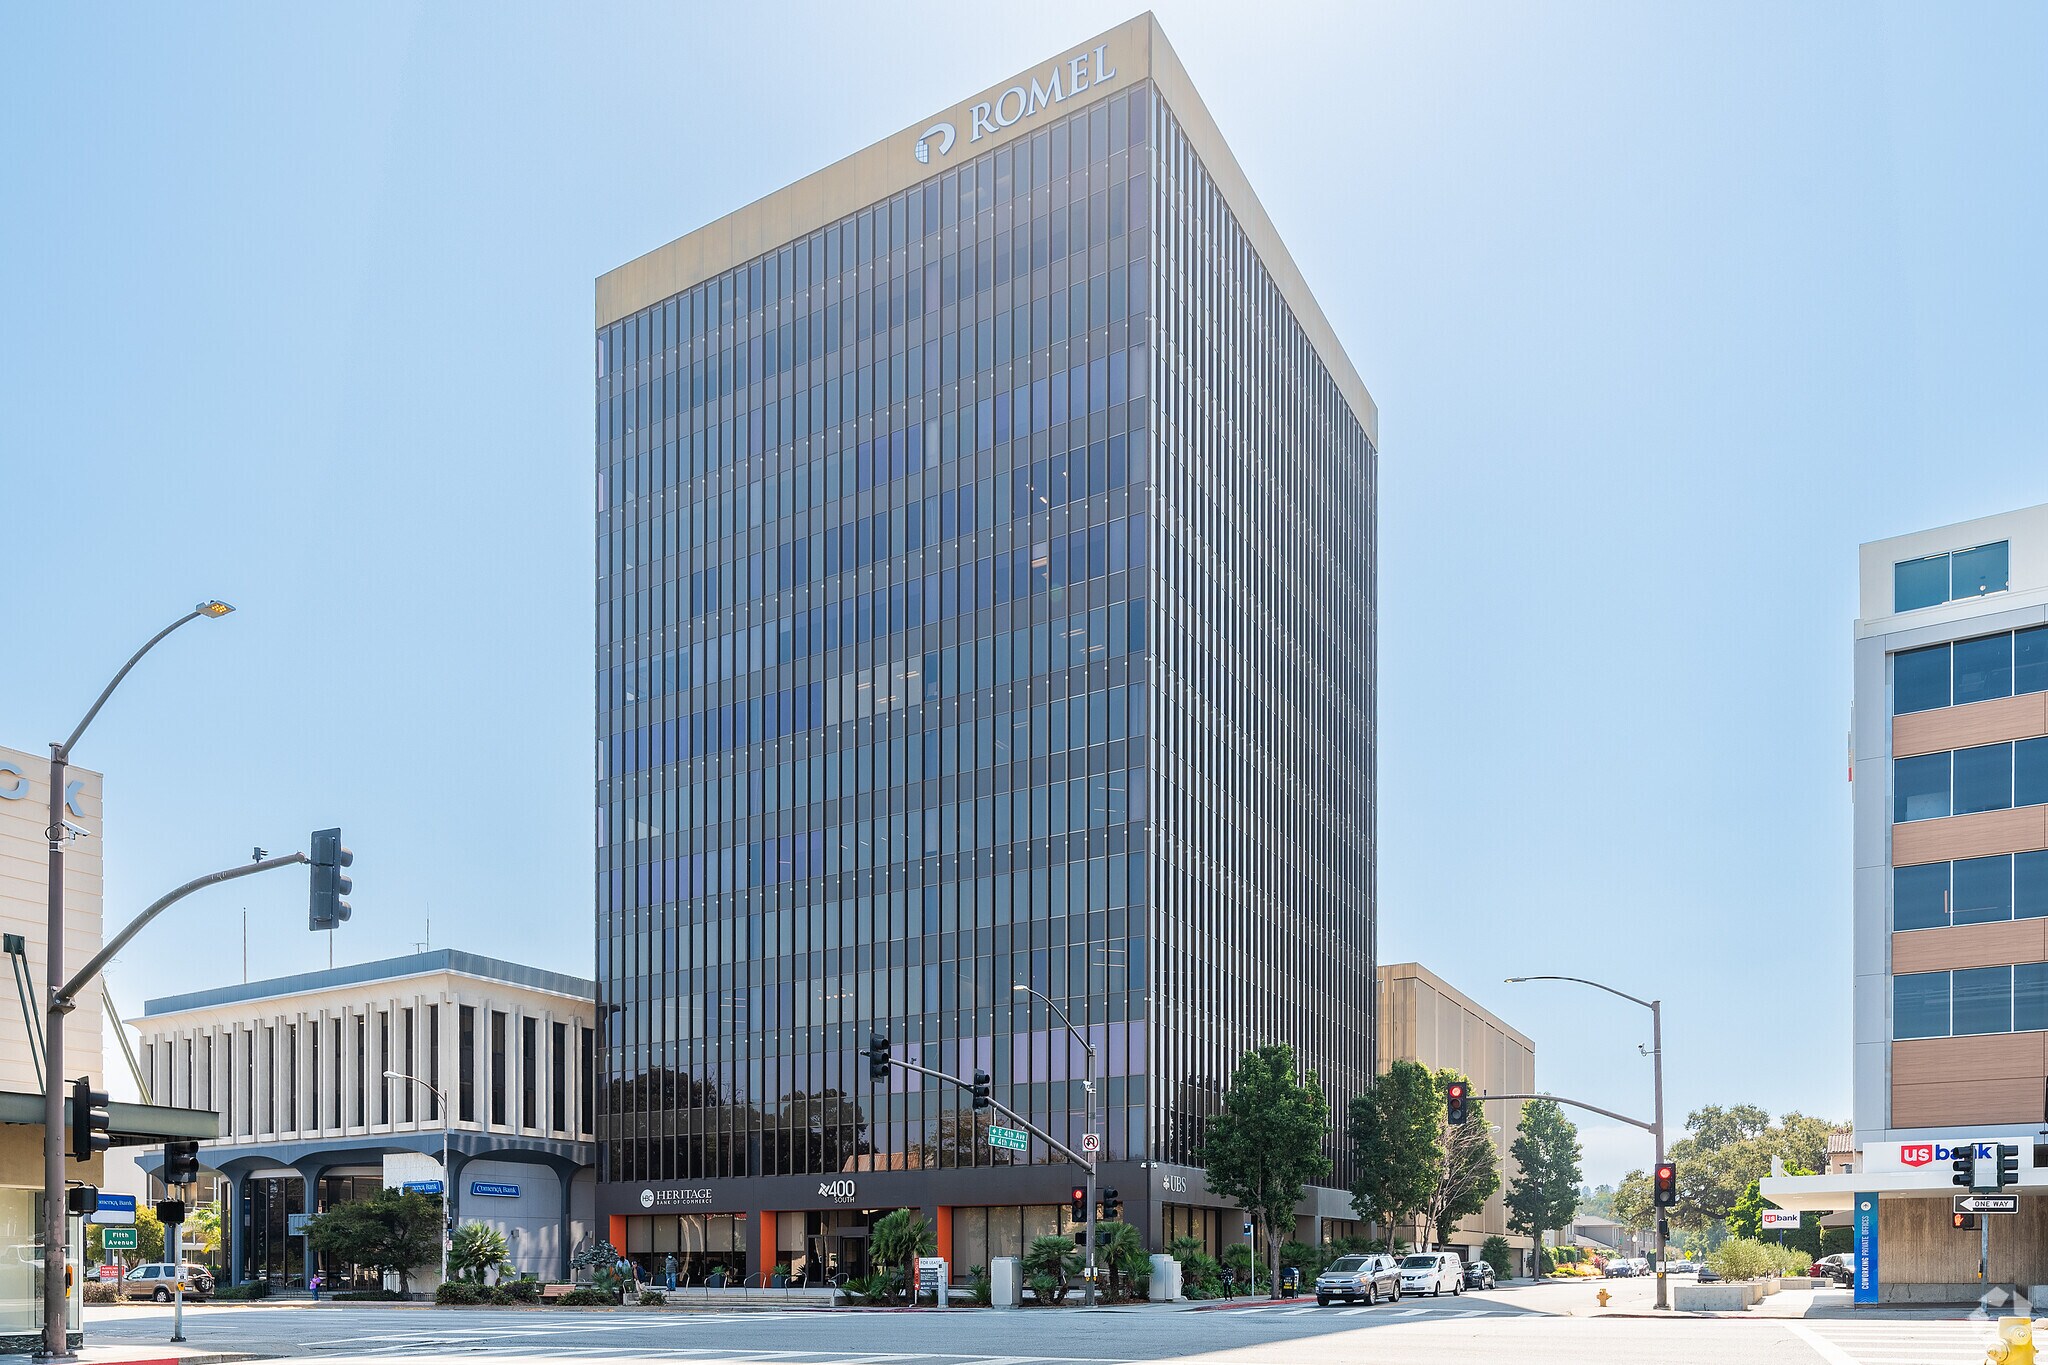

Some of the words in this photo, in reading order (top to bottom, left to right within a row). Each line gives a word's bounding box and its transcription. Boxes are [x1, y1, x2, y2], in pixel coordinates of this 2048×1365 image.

[969, 43, 1116, 144] ROMEL
[1016, 1132, 1025, 1140] Ave
[828, 1180, 855, 1197] 400
[1170, 1175, 1187, 1193] UBS
[656, 1188, 712, 1200] HERITAGE
[1861, 1215, 1869, 1235] OFFICES
[1861, 1236, 1869, 1256] PRIVATE
[1861, 1257, 1869, 1290] COWORKING
